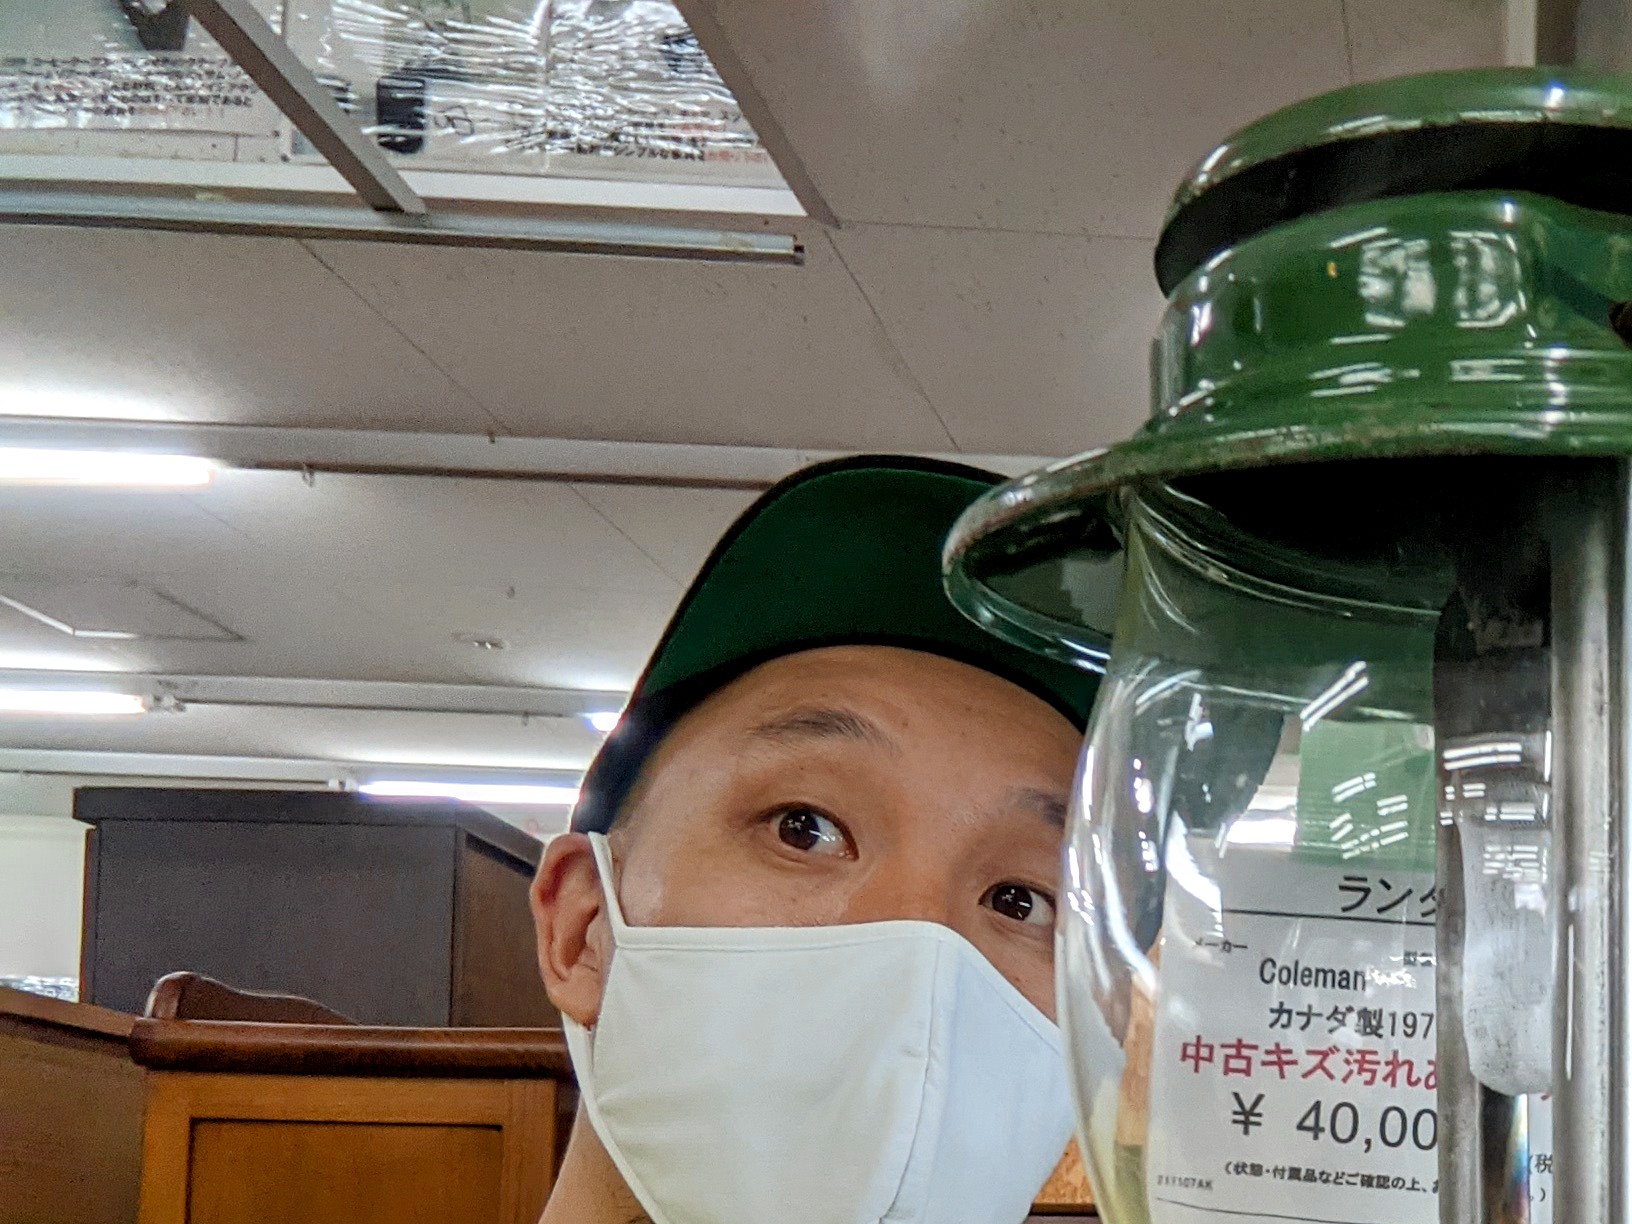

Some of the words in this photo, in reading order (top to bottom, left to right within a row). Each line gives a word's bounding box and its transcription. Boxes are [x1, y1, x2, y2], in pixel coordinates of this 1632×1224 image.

[1259, 957, 1367, 991] Coleman
[1268, 1001, 1434, 1039] カナダ製197
